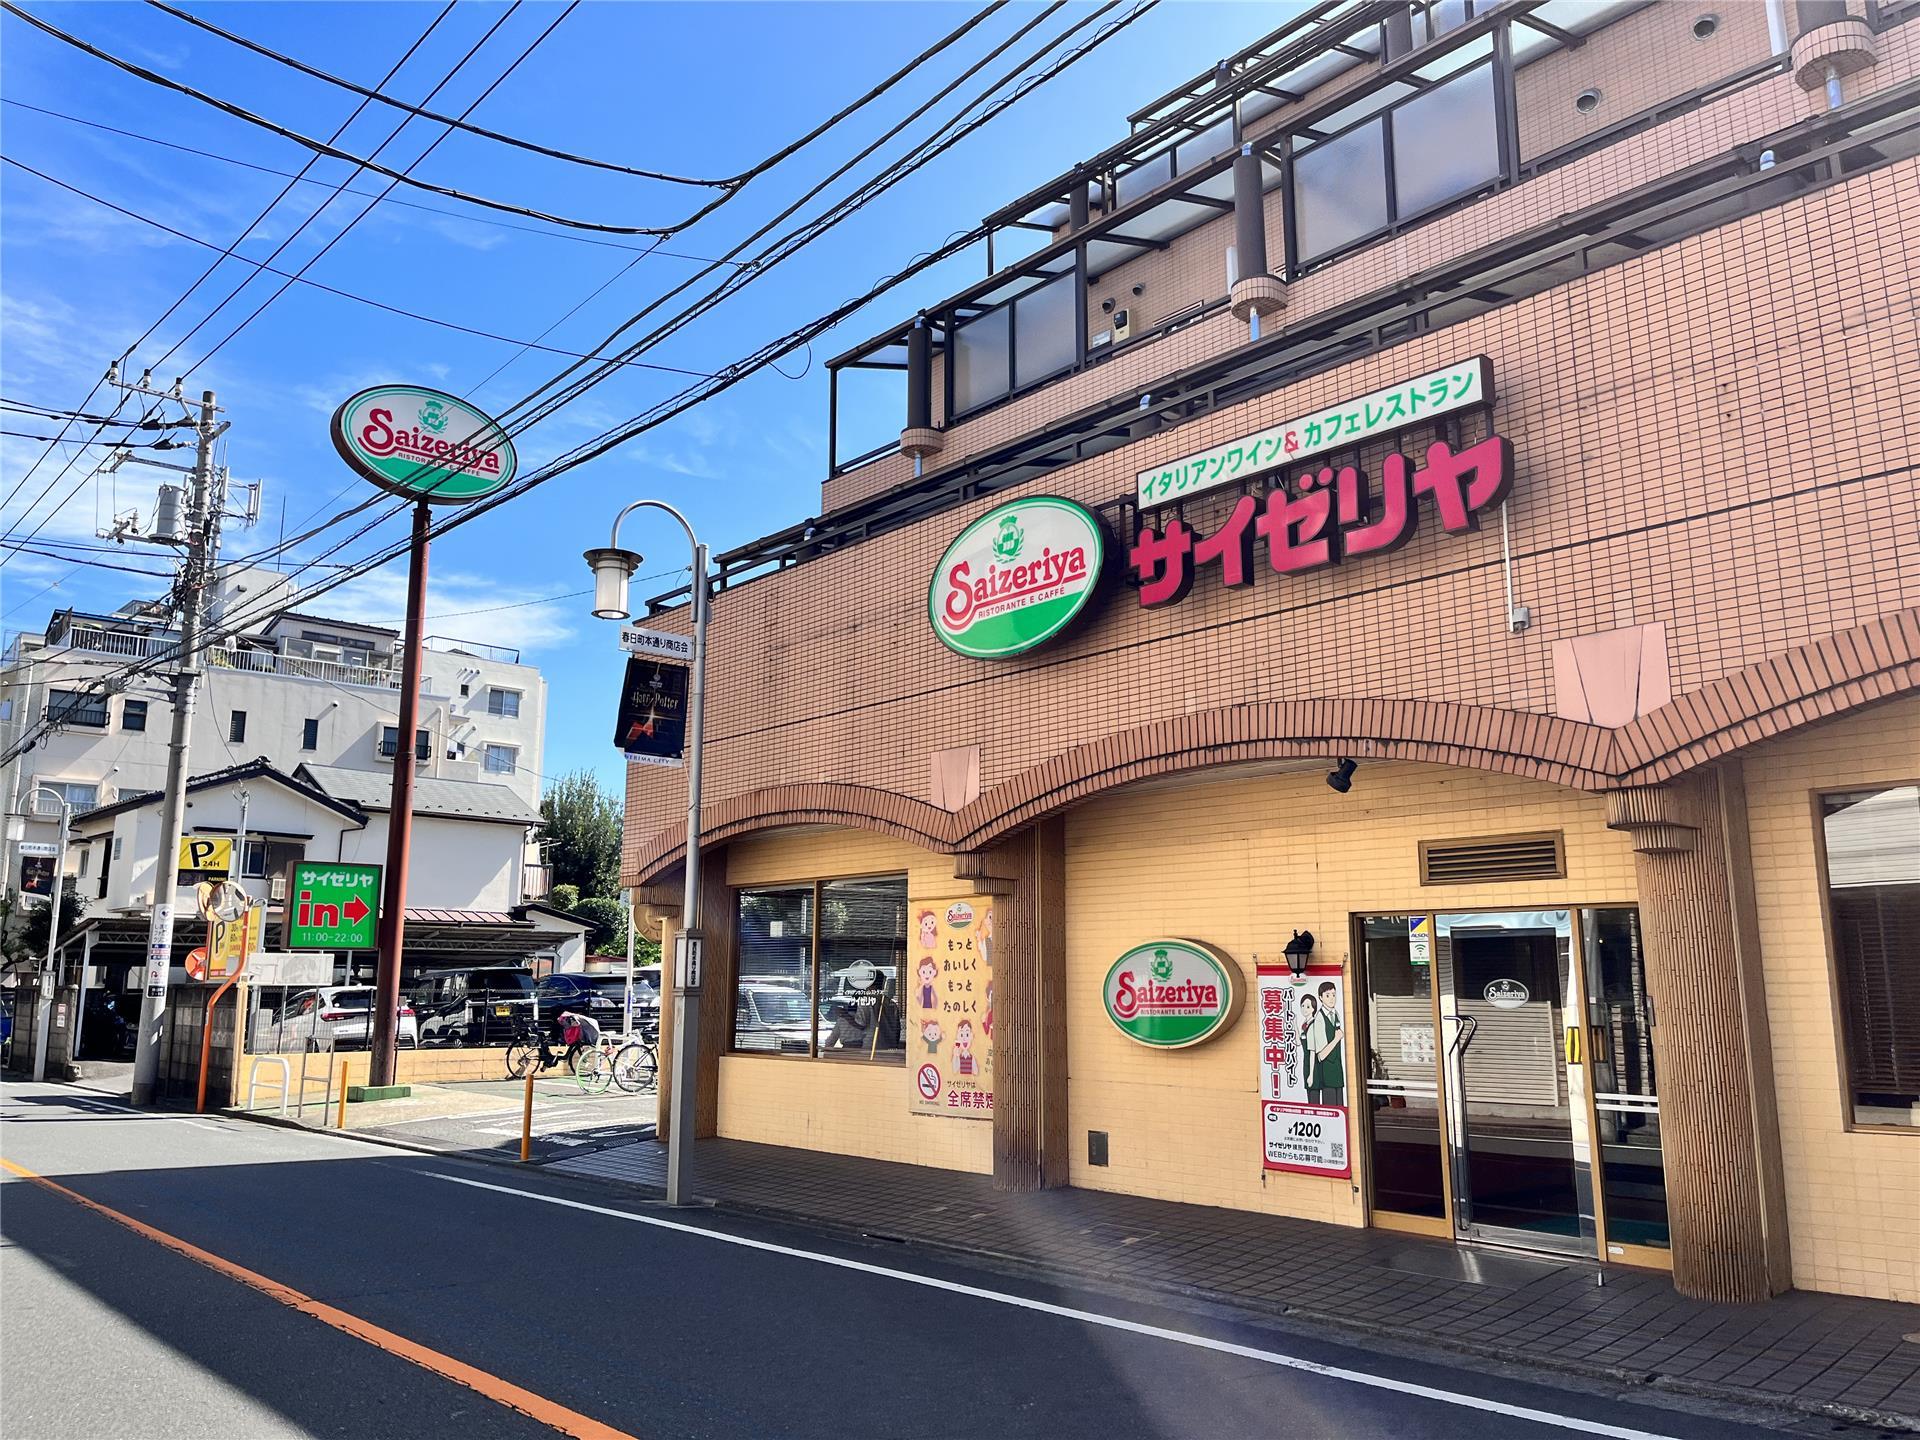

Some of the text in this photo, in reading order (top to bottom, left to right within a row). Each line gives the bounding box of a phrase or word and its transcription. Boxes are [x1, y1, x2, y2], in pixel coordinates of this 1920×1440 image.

[358, 408, 499, 474] Saizeriya
[1130, 435, 1504, 608] サイゼリヤ
[937, 547, 1087, 631] Saizeriya
[978, 598, 1026, 619] RISTORANTE
[1029, 595, 1035, 604] E
[621, 631, 688, 653] 春日町本通り商店会
[189, 841, 215, 868] P
[302, 871, 374, 887] サイゼリヤ
[297, 890, 340, 928] in
[302, 932, 363, 943] 11:00-22:00
[948, 938, 972, 951] もっと
[943, 958, 976, 972] おいしく
[948, 979, 972, 992] もっと
[1113, 971, 1218, 1018] Saizeriya
[1487, 986, 1526, 1001] Saizeriya
[943, 1000, 977, 1013] たのしく
[1262, 989, 1286, 1097] 募集中!
[1284, 989, 1297, 1086] パート・アルバイト
[1288, 1121, 1321, 1138] ¥1200
